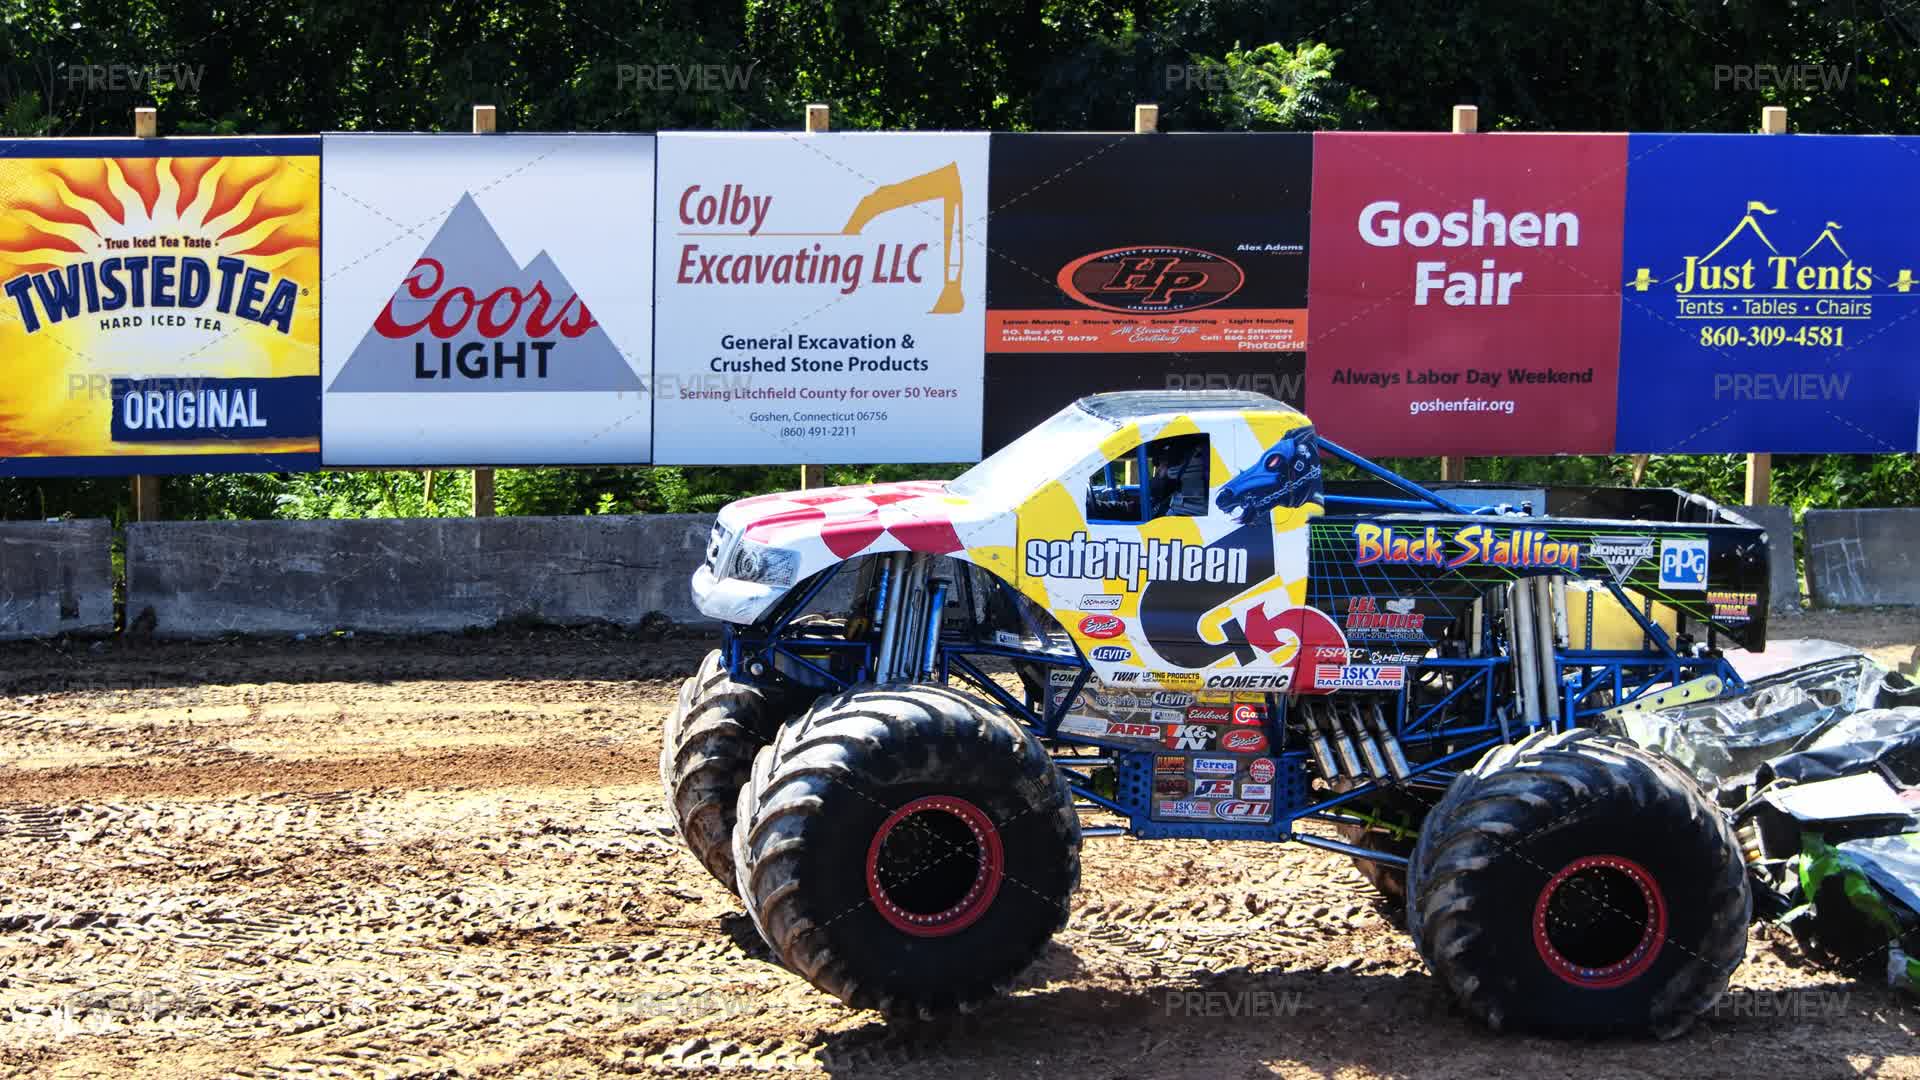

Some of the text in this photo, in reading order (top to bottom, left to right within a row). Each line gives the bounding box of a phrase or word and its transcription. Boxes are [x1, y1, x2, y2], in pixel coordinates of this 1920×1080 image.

[679, 184, 772, 236] Colby
[1358, 199, 1580, 247] Goshen
[105, 236, 212, 249] True Iced Tea Taste
[1265, 243, 1304, 251] Adams
[677, 243, 928, 295] Excavating LLC
[1675, 256, 1873, 293] Just Tents
[1103, 257, 1209, 305] HP
[1414, 259, 1523, 306] Fair
[5, 255, 298, 334] TWISTED TEA
[374, 257, 598, 339] Coors
[1676, 299, 1872, 315] Tents Tables Chairs
[101, 315, 221, 331] HARD ICED TEA
[721, 334, 915, 351] General Excavation &
[1700, 326, 1844, 347] 860-309-4581
[1238, 341, 1305, 350] PhotoGrid
[415, 341, 556, 379] LIGHT
[710, 356, 929, 373] Crushed Stone Products
[1332, 368, 1593, 388] Always Labor Day Weekend
[680, 386, 958, 402] Serving Litchfield County for over 50 Years
[123, 389, 267, 429] ORIGINAL
[1410, 399, 1515, 414] goshenfair.org
[750, 411, 888, 422] Goshen, Connecticut 06756
[780, 427, 857, 439] (860) 491-2211
[1354, 522, 1580, 569] Black Stallion
[1590, 545, 1653, 557] MONSTER
[1026, 532, 1248, 592] safety-kleen
[1607, 556, 1634, 565] JAM
[1707, 591, 1757, 605] MONSTER
[1346, 613, 1424, 629] HYDRAULICS
[1091, 650, 1131, 661] CLEVITE
[1111, 671, 1200, 682] TWAY LIFTING PRODUCTS
[1342, 667, 1380, 680] ISKY
[1207, 675, 1288, 689] COMETIC
[1318, 679, 1401, 687] RACING CAMS
[1153, 692, 1192, 707] CLEVITE
[1188, 709, 1229, 721] Edelbrock
[1109, 724, 1159, 736] ARP
[1195, 760, 1234, 769] Ferrea
[1195, 781, 1232, 796] JE
[1175, 802, 1195, 811] ISKY
